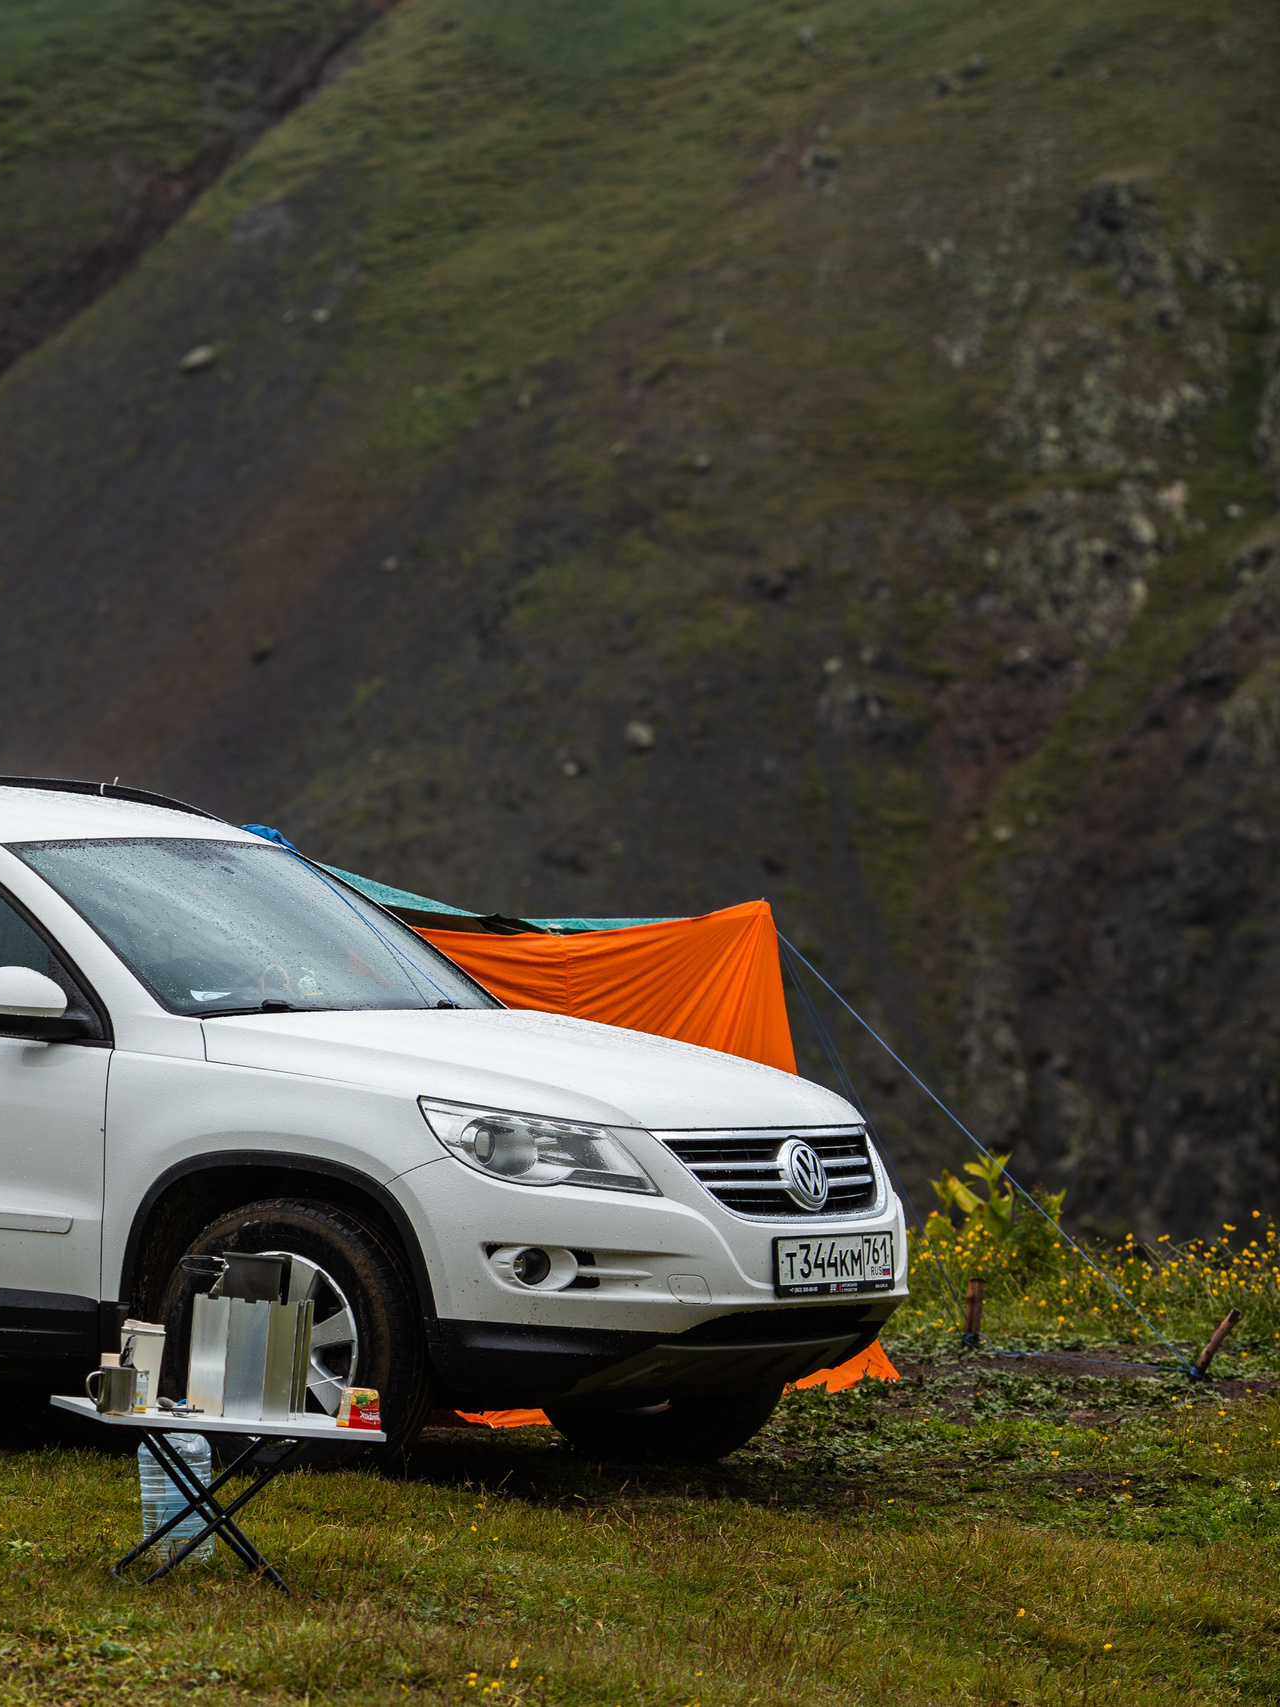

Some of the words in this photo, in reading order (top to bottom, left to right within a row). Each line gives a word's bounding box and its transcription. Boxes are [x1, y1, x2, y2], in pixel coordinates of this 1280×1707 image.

[785, 1242, 863, 1280] Т344КМ
[864, 1237, 888, 1265] 761
[871, 1265, 882, 1276] RUS
